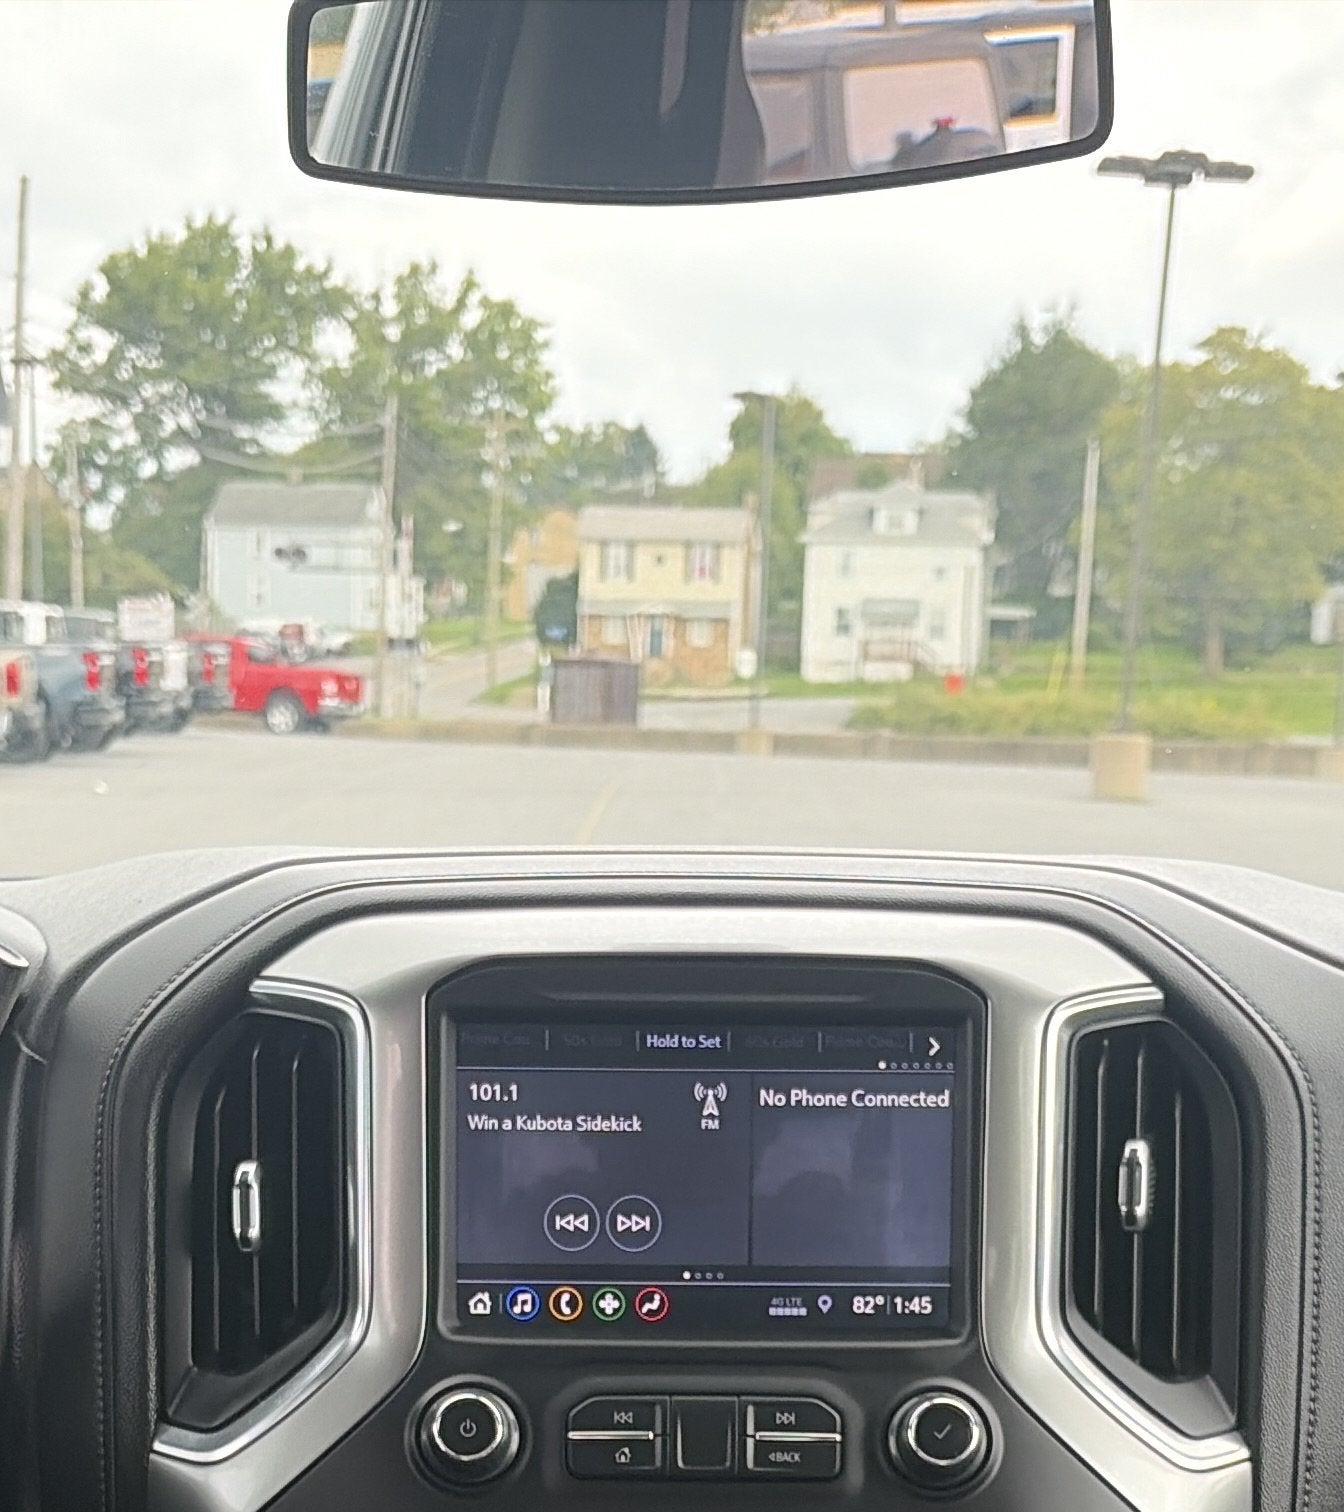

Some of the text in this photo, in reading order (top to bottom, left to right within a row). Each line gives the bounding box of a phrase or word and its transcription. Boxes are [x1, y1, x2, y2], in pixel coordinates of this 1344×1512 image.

[646, 1033, 722, 1049] Hold to Set
[469, 1083, 519, 1102] 101.1
[759, 1088, 950, 1108] No Phone Connected
[467, 1114, 642, 1132] Win a Kubota Sidekick
[700, 1118, 720, 1130] FM
[771, 1297, 803, 1307] 4G LTE
[893, 1295, 933, 1315] 1:45
[775, 1451, 801, 1463] BACK
